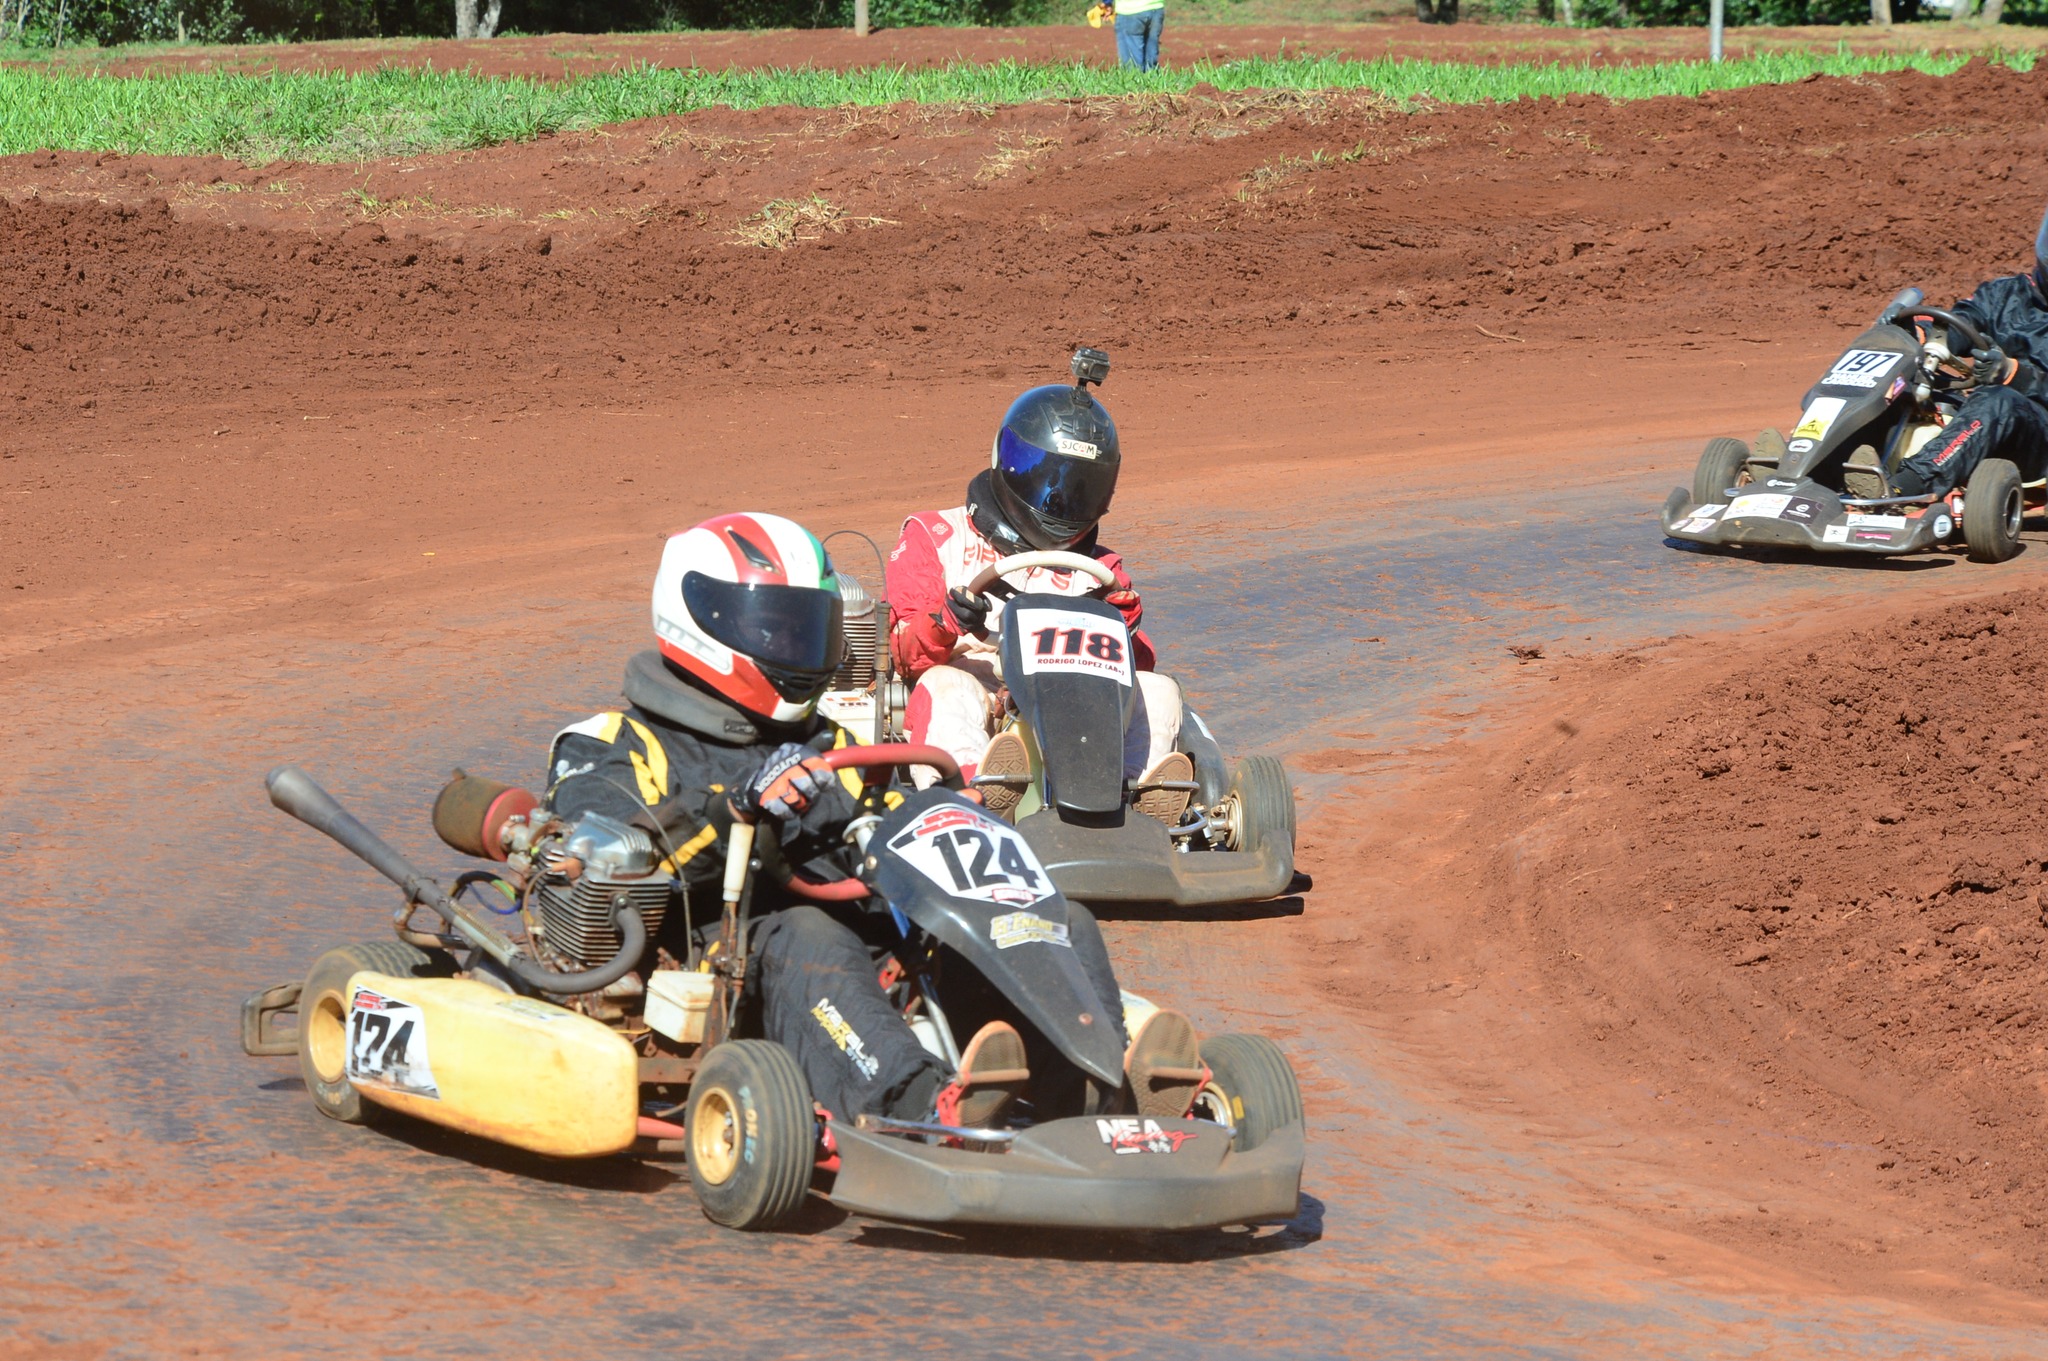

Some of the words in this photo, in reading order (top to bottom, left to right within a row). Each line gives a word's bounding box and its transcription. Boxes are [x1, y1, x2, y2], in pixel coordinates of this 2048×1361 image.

[1836, 352, 1898, 374] 197
[1031, 626, 1125, 664] 118
[1078, 659, 1103, 669] LOPEZ
[753, 752, 802, 793] OUTDOOR
[931, 828, 1041, 892] 124
